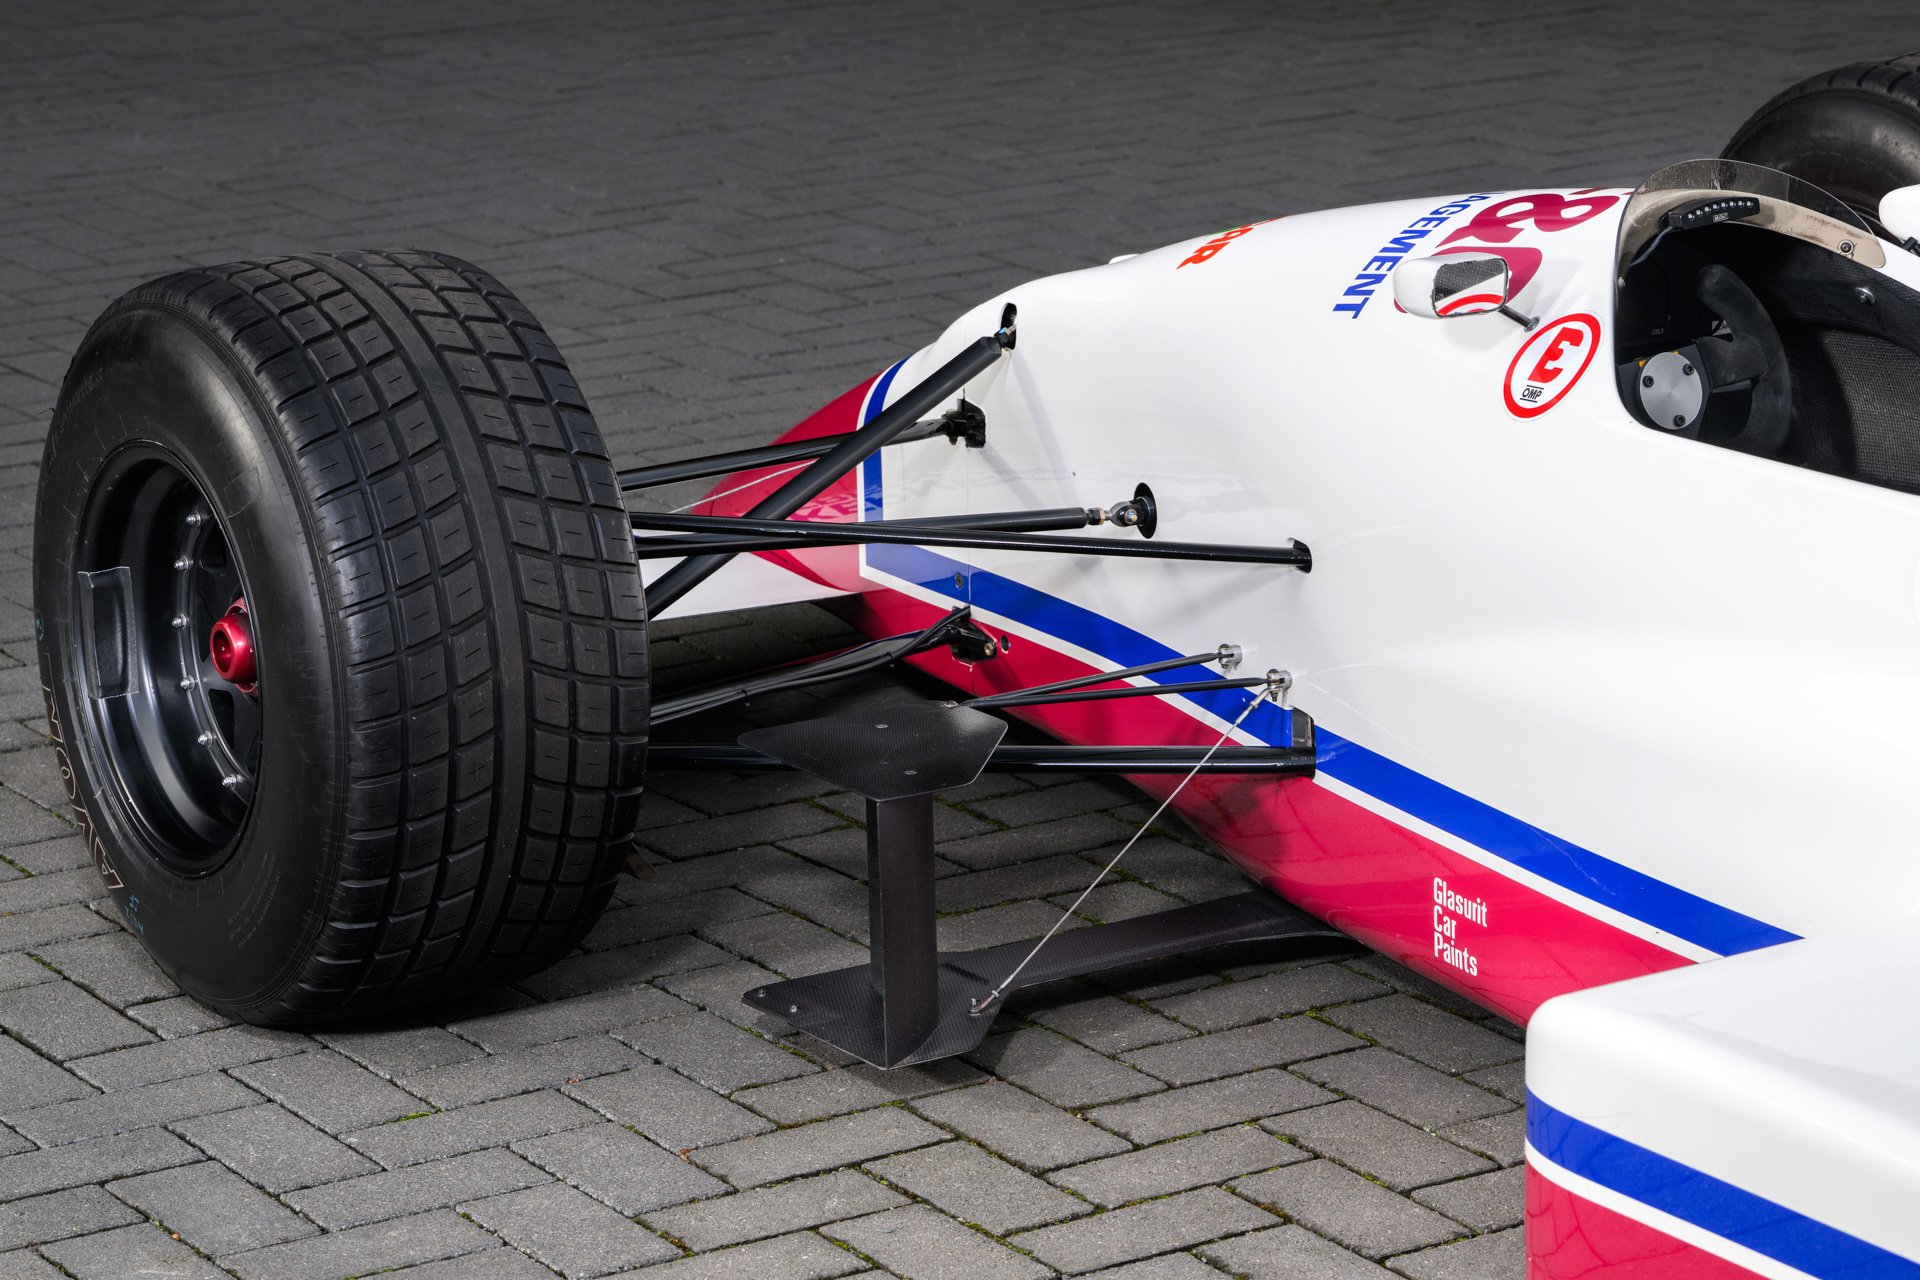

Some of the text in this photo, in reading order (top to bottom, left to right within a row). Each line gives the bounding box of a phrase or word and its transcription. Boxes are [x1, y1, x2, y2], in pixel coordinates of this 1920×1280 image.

[1333, 193, 1502, 319] AGEMENT
[1527, 327, 1584, 384] E
[1522, 387, 1543, 400] OMP
[42, 684, 124, 889] AVON
[1433, 877, 1488, 927] Glasurit
[1433, 905, 1457, 940] Car
[1433, 931, 1478, 977] Paints
